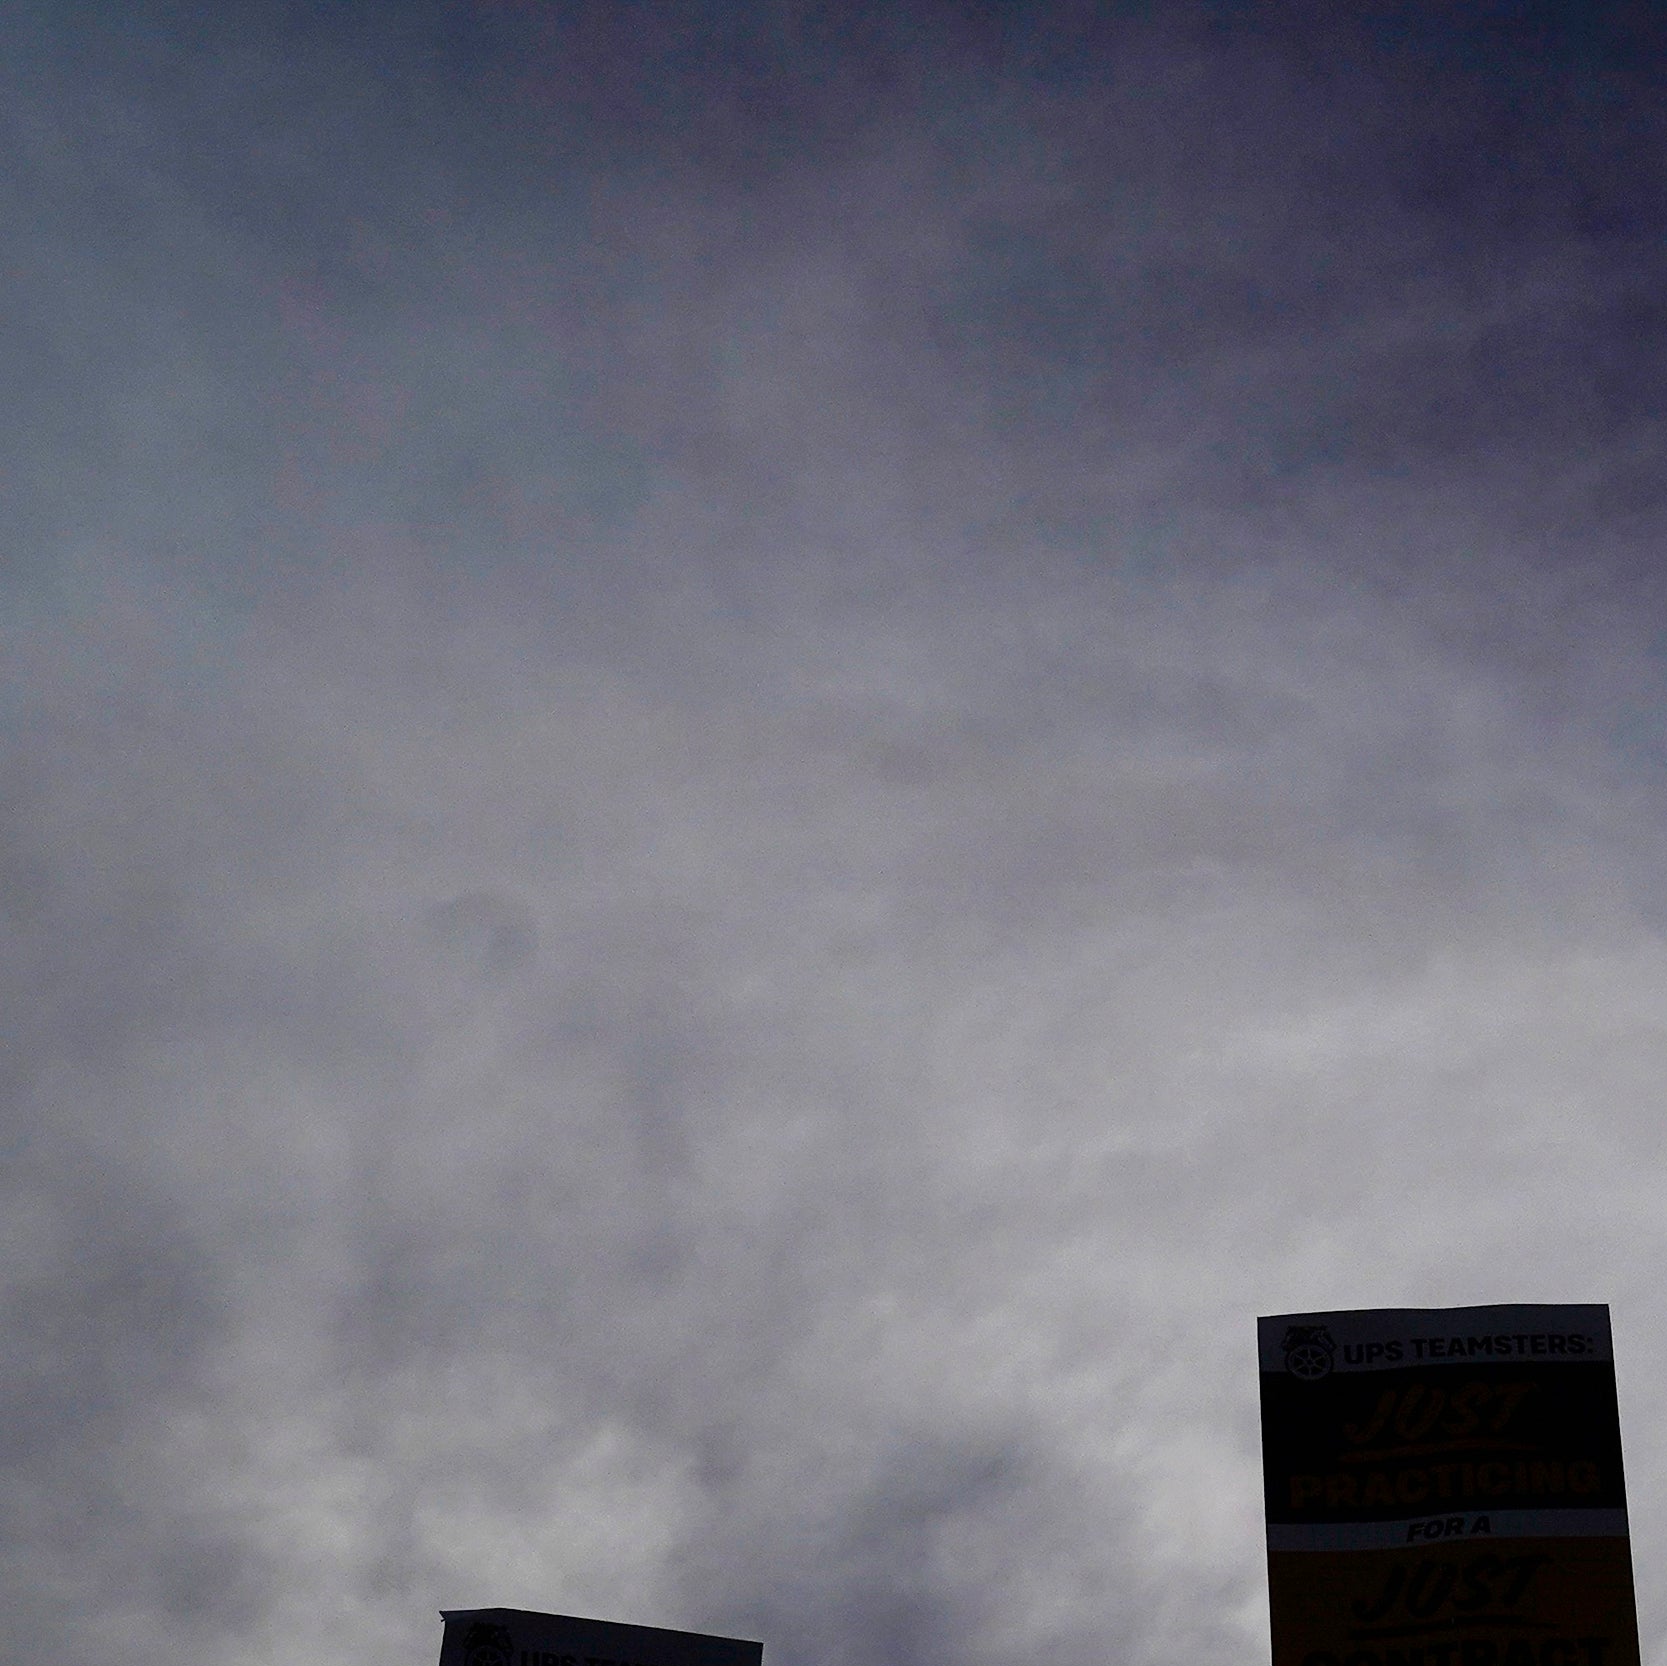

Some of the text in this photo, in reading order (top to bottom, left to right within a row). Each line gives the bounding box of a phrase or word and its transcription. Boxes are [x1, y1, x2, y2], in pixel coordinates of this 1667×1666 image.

[1343, 1333, 1595, 1366] UPS TEAMSTERS:
[1342, 1381, 1540, 1447] JUST
[1288, 1459, 1602, 1510] PRACTICING
[1406, 1514, 1492, 1542] FOR A
[1350, 1554, 1555, 1624] JUST
